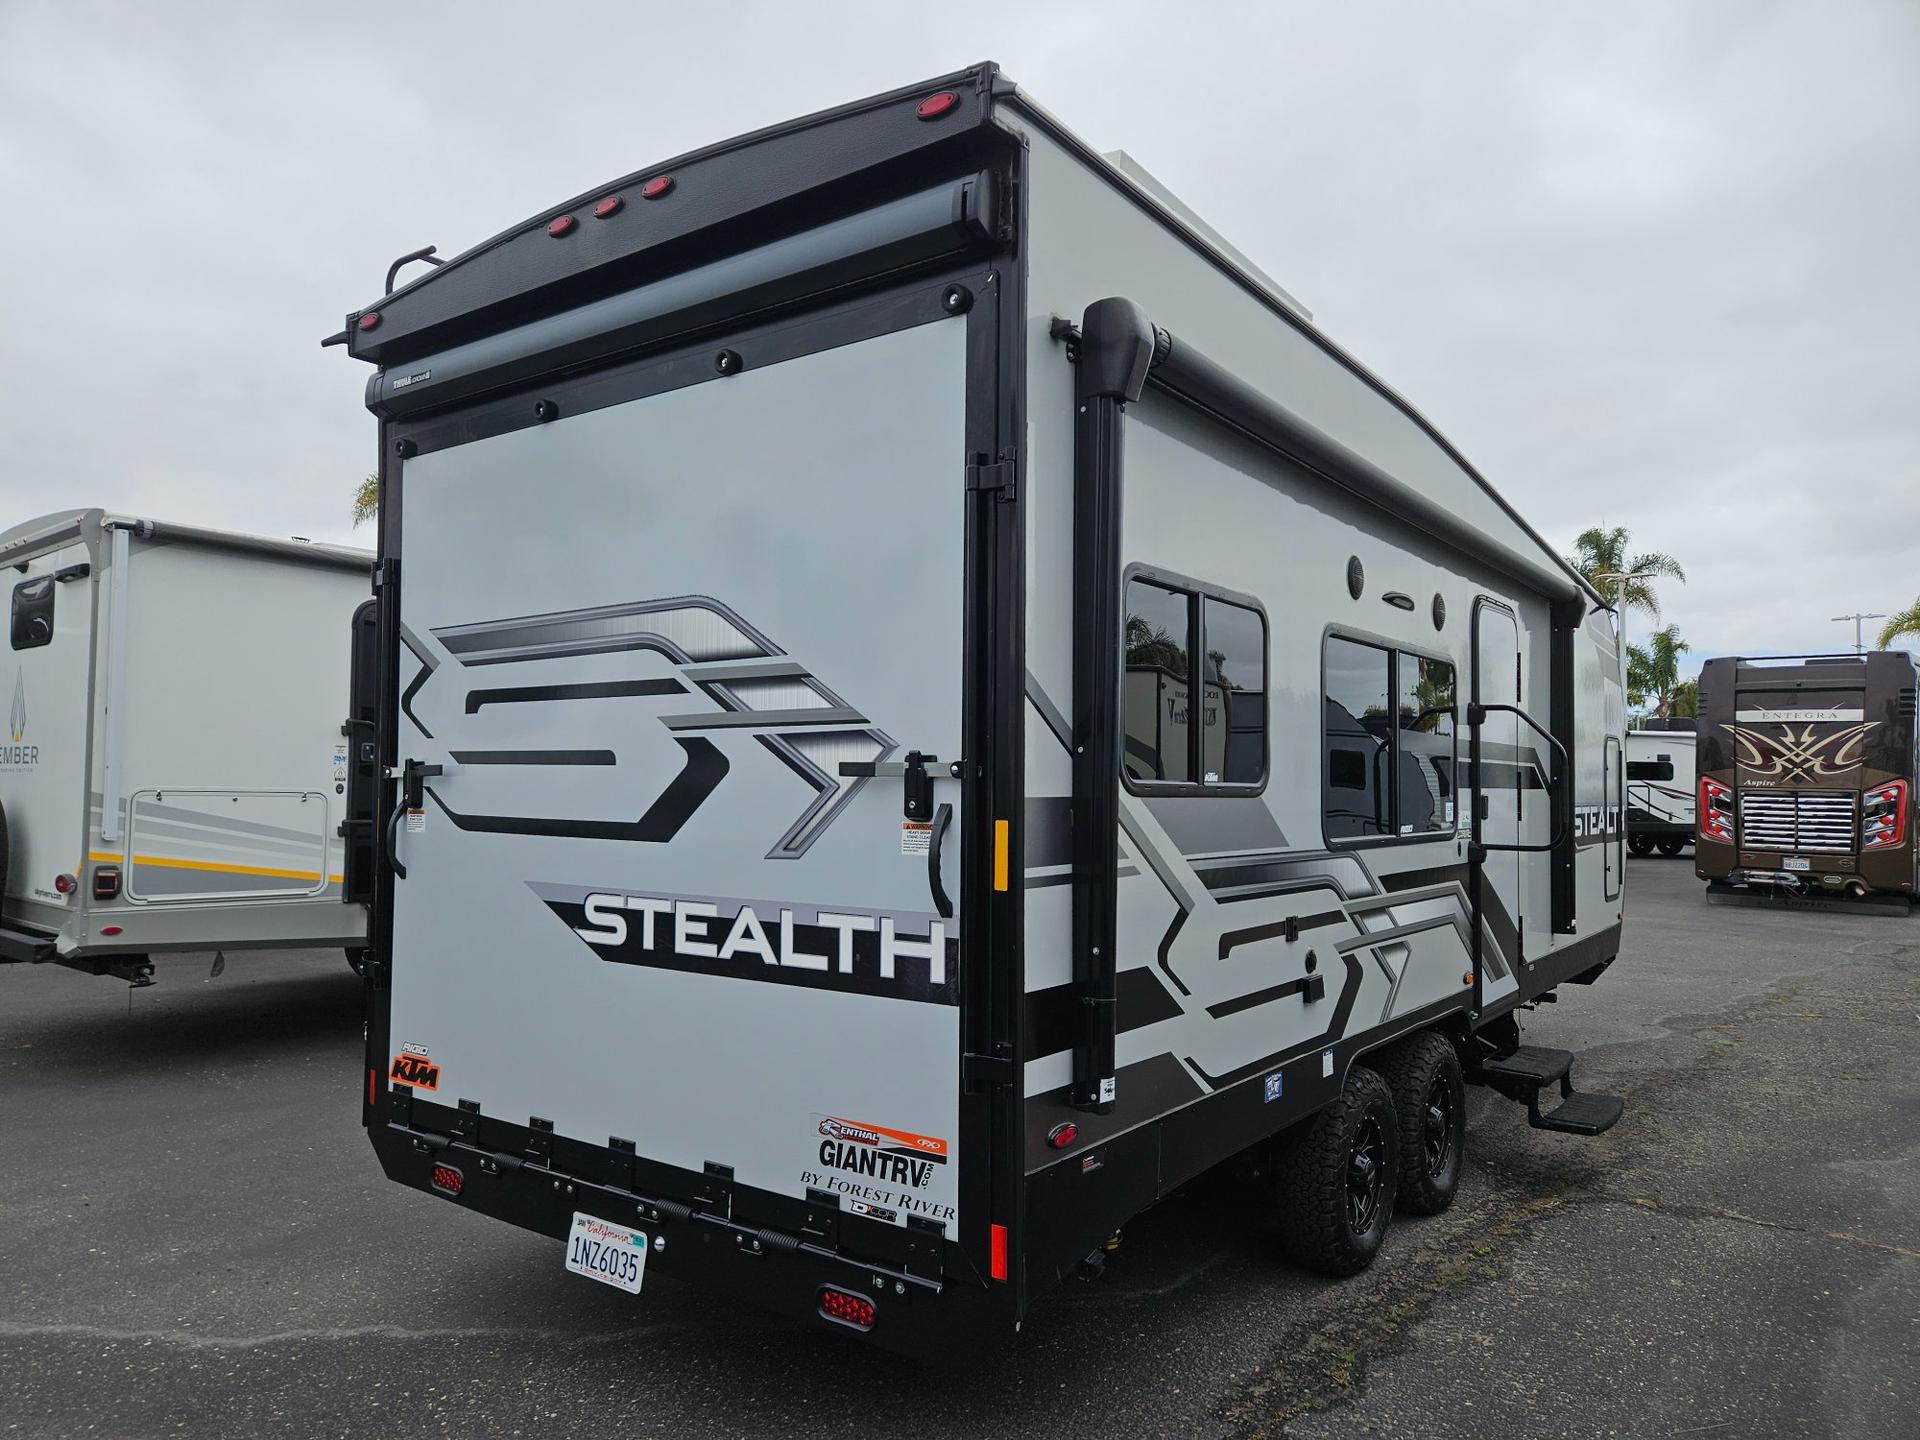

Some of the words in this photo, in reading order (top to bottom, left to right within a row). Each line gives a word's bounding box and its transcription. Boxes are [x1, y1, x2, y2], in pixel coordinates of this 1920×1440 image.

[1762, 711, 1839, 721] ENTEGRA
[1744, 779, 1776, 787] Aspire
[574, 893, 946, 985] STEALTH
[392, 1056, 438, 1087] KTM
[819, 1140, 927, 1188] GIANTRV
[800, 1171, 823, 1185] BY
[827, 1176, 894, 1203] FOREST
[898, 1194, 956, 1220] RIVER
[587, 1220, 632, 1246] California
[571, 1236, 638, 1282] 1NZ6035
